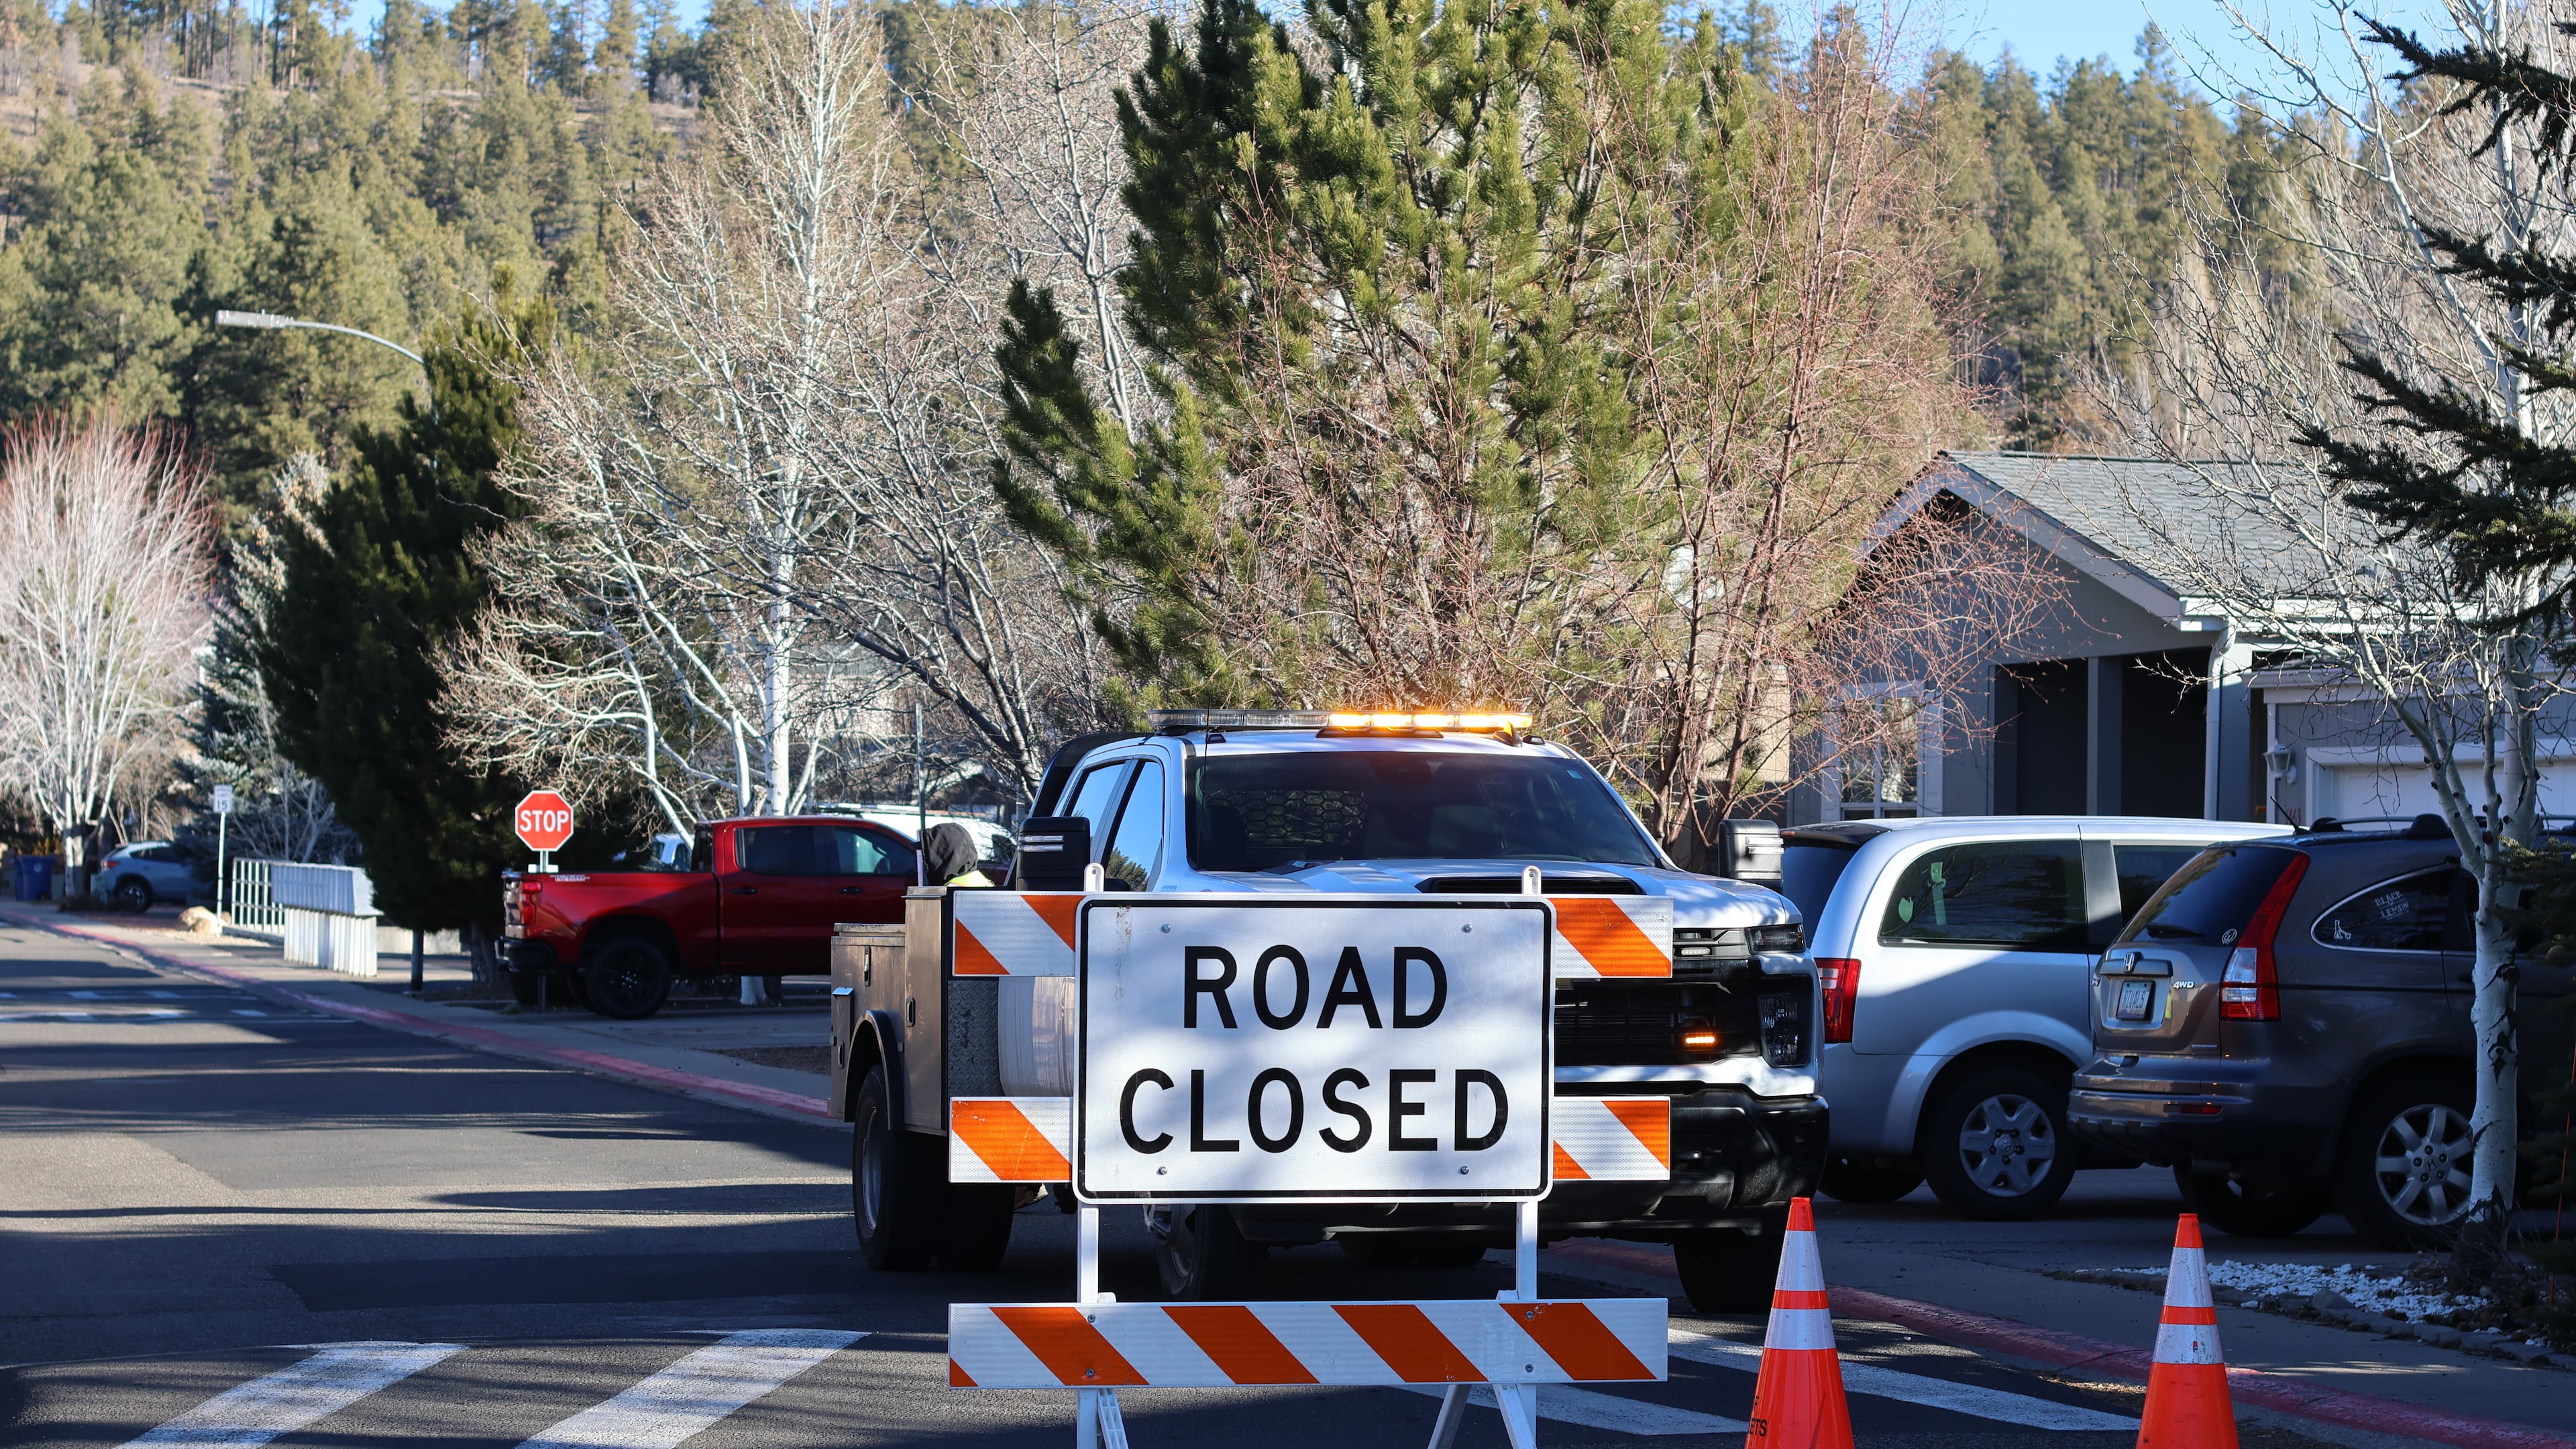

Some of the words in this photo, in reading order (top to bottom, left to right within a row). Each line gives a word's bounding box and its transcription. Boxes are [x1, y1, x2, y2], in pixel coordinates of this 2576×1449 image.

[218, 800, 227, 810] 15
[519, 810, 569, 833] STOP
[2375, 891, 2403, 906] BLACK
[2380, 902, 2410, 918] LEMON
[1184, 945, 1447, 1030] ROAD
[2174, 981, 2194, 989] 4WD
[2123, 989, 2146, 1008] RIVALS
[1120, 1068, 1508, 1154] CLOSED
[1750, 1417, 1768, 1437] ETS
